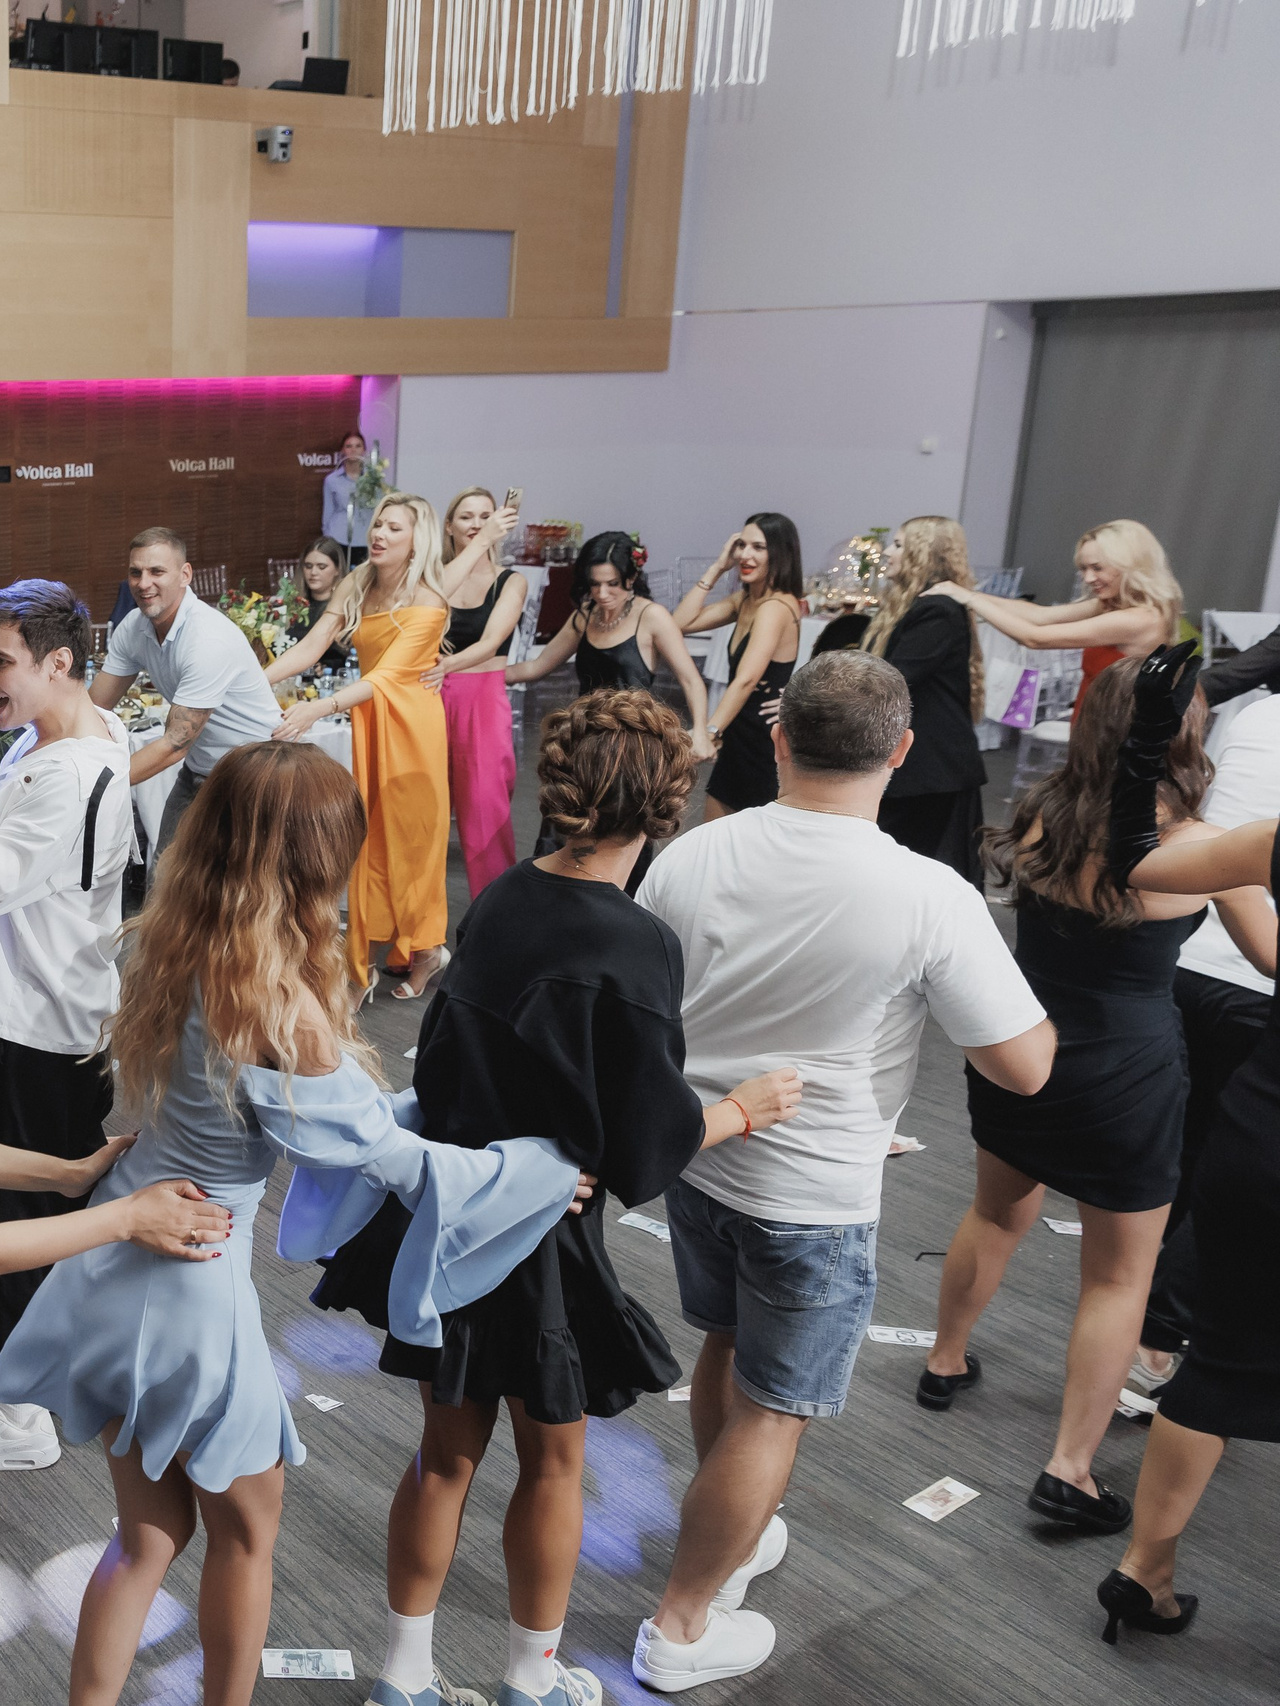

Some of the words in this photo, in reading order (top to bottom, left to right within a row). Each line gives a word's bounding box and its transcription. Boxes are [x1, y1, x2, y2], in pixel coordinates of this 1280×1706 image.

[21, 465, 62, 480] Volga
[64, 462, 94, 478] Hall
[169, 458, 207, 472] Volga
[209, 456, 235, 470] Hall
